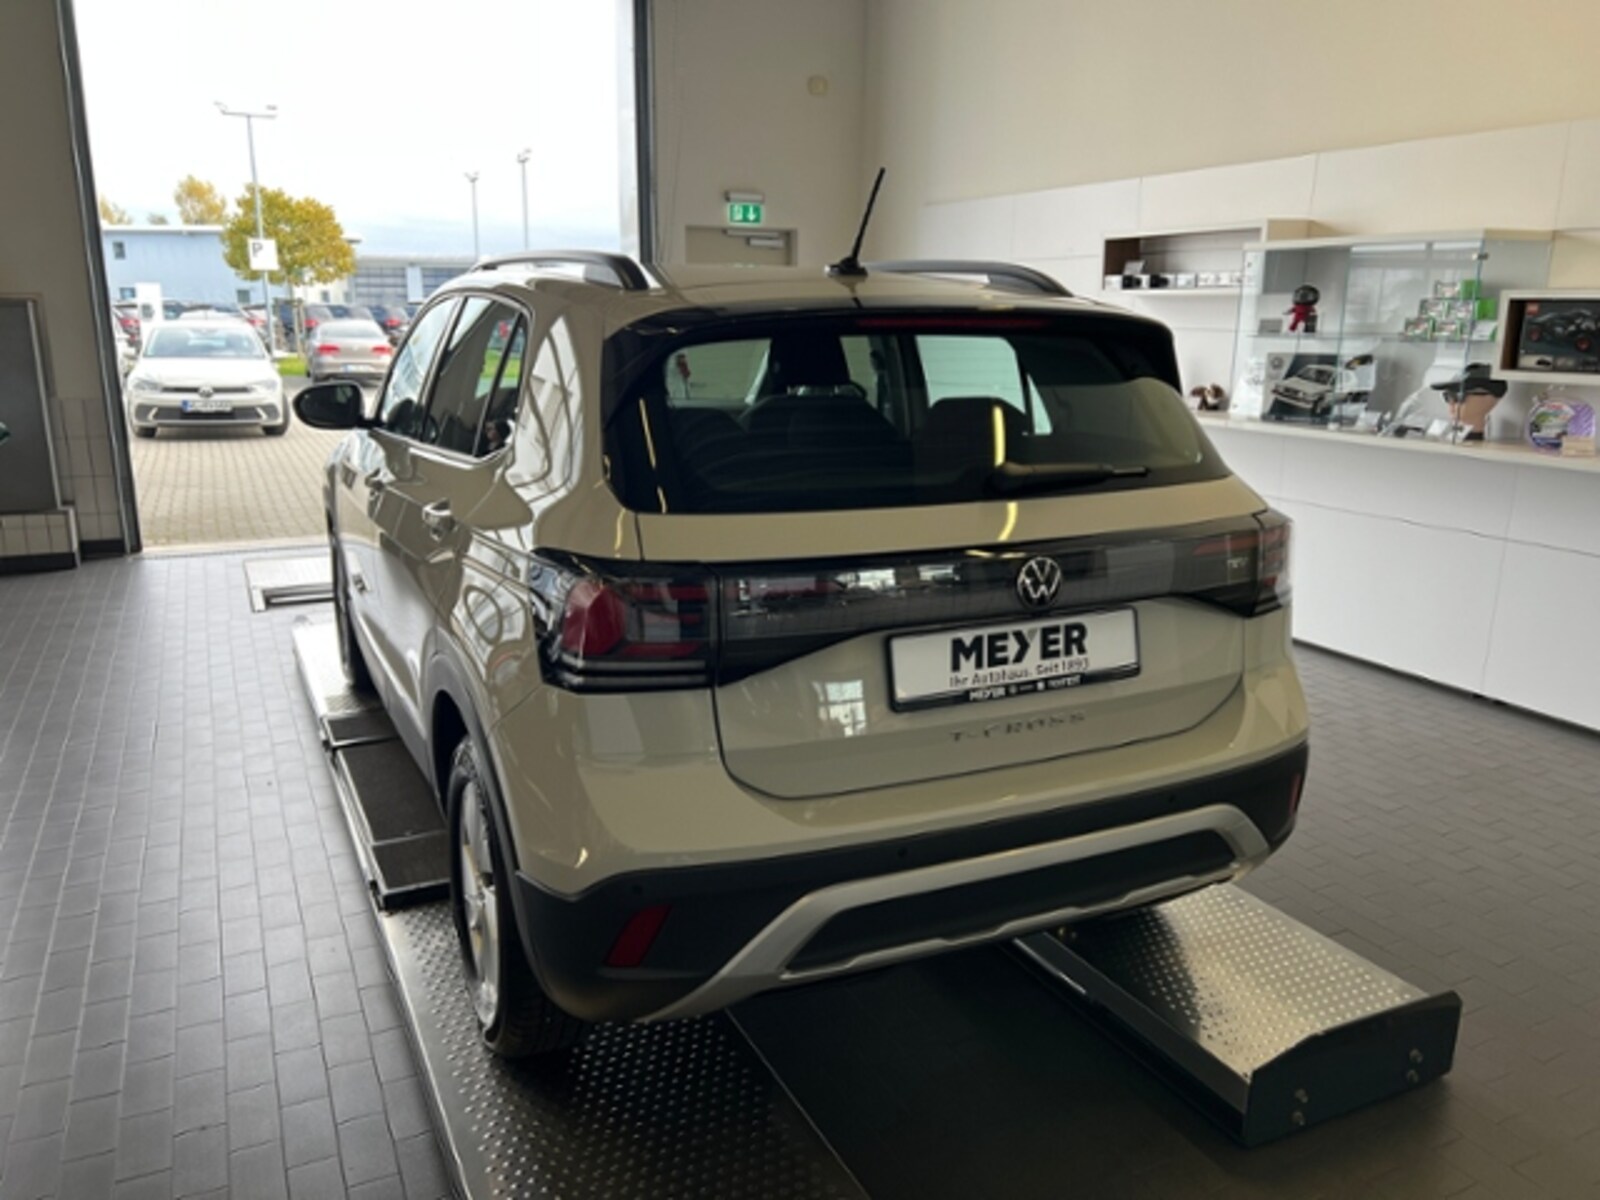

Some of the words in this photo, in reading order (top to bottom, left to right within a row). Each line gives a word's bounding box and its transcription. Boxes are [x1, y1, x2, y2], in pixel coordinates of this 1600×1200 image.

[252, 242, 264, 258] P
[951, 622, 1088, 672] MEYER
[949, 674, 968, 688] Ihr
[1035, 663, 1059, 677] Seit
